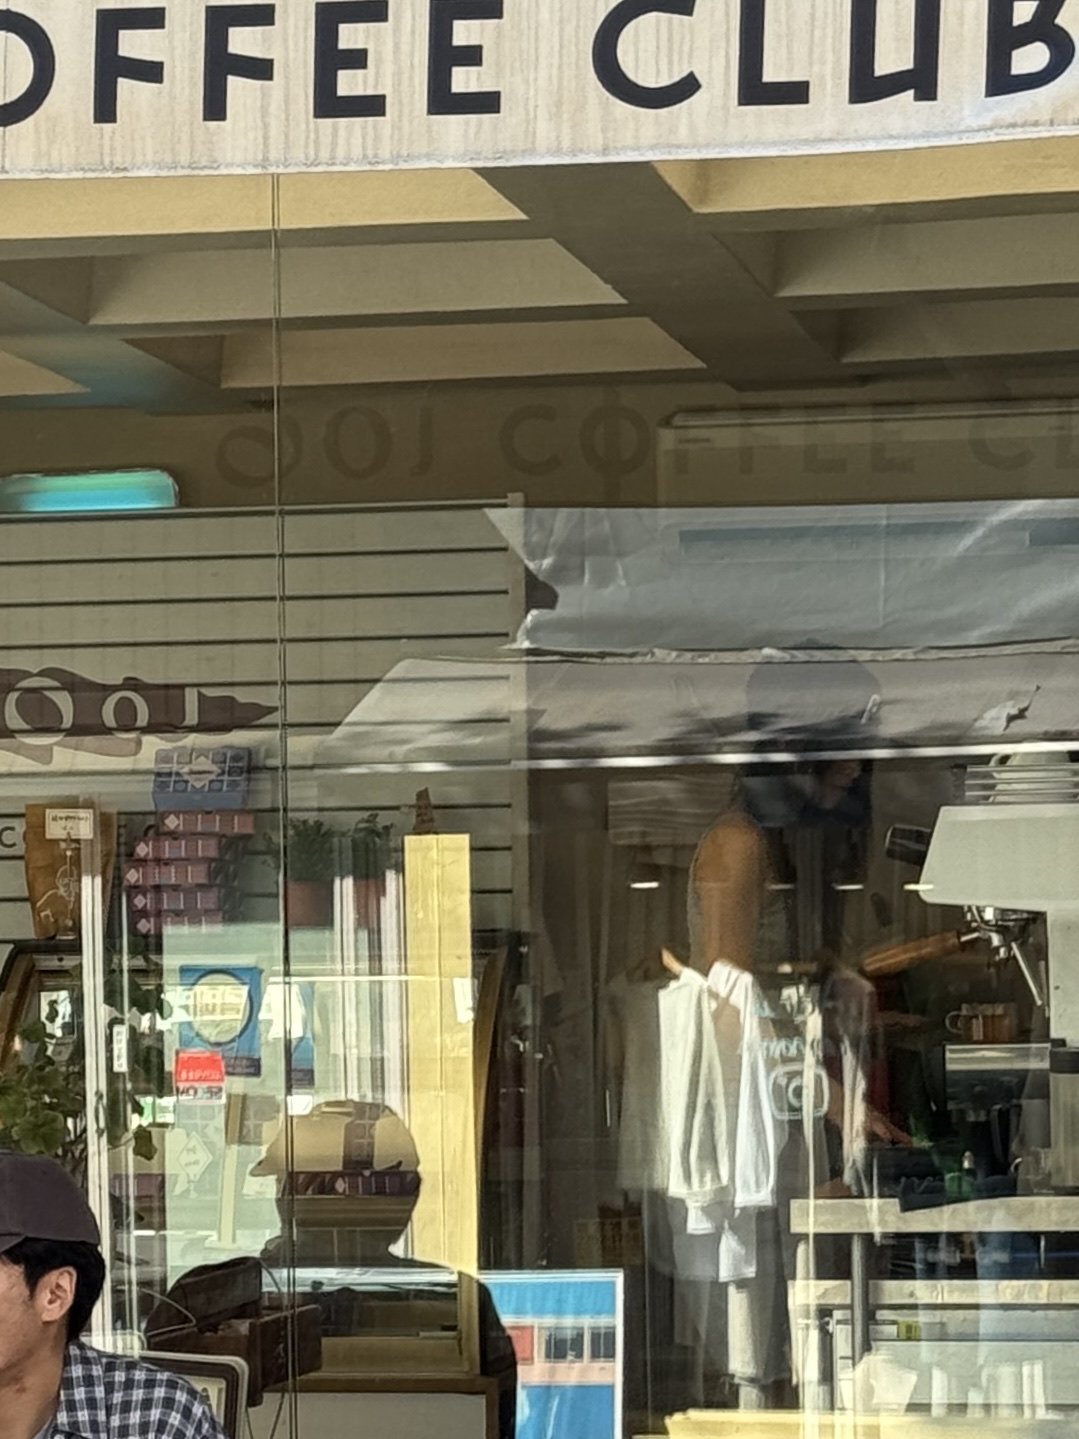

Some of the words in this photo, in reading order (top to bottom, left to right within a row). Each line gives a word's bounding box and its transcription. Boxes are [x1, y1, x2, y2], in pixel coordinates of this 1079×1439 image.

[591, 0, 1076, 110] CLUB
[214, 404, 435, 488] OOJ
[3, 675, 200, 746] OOJ
